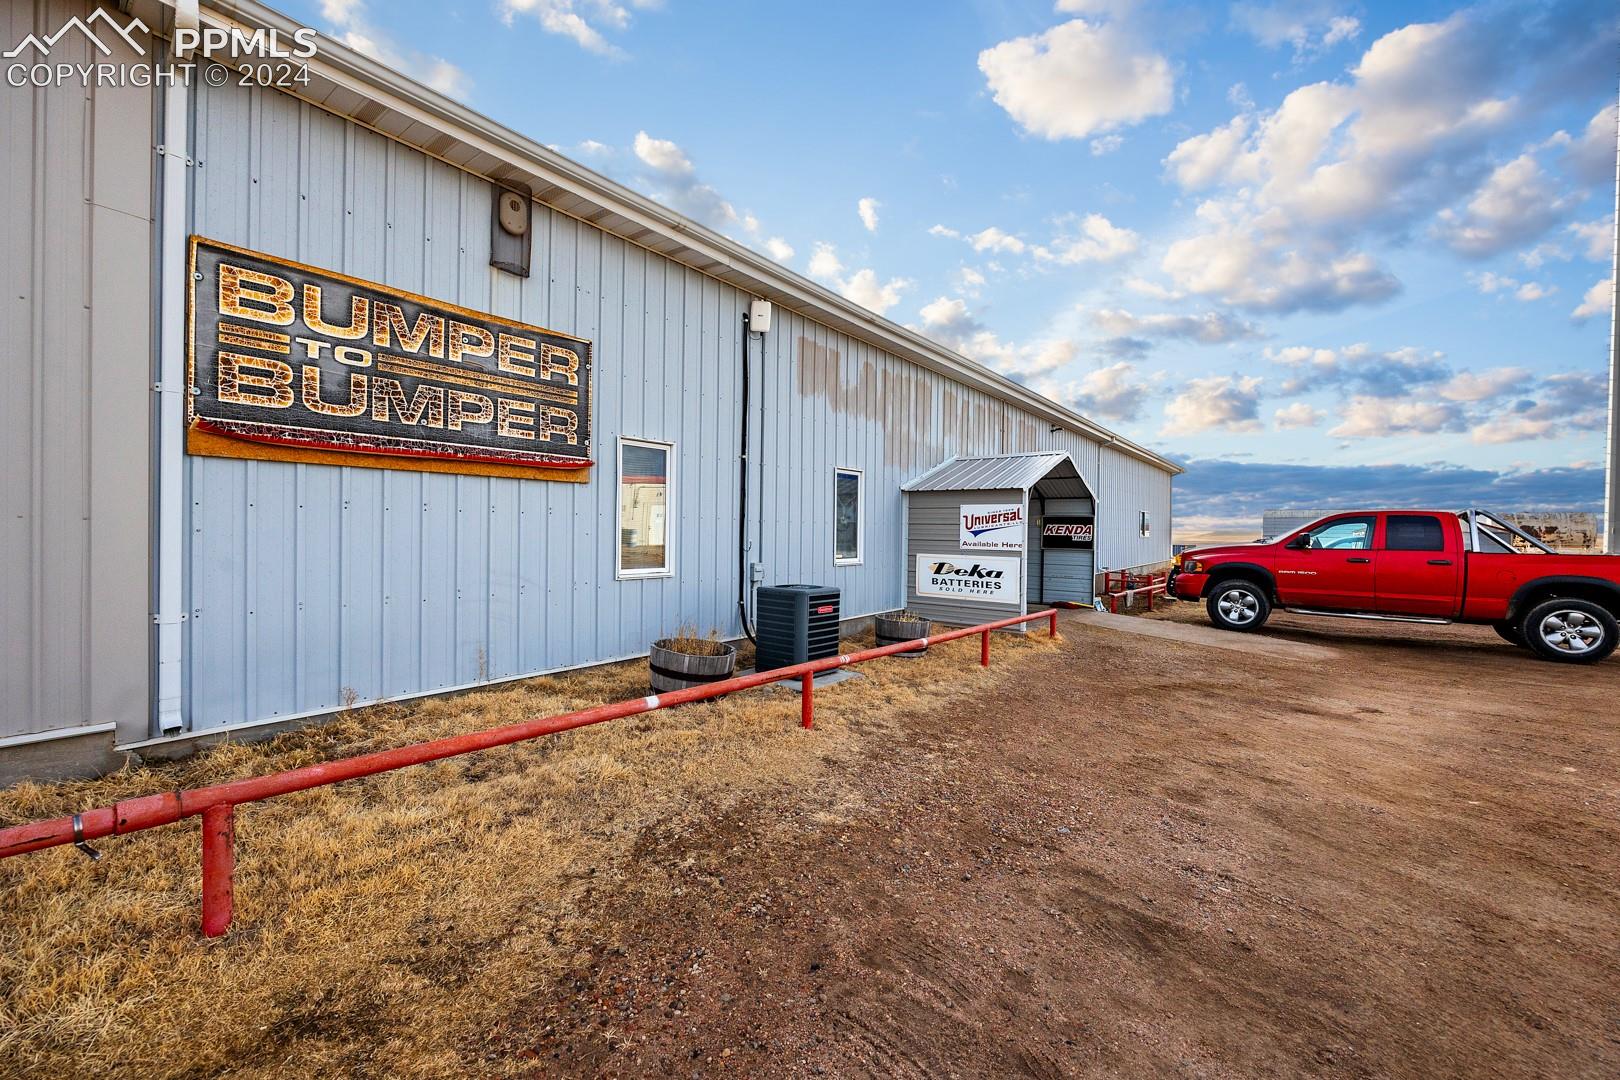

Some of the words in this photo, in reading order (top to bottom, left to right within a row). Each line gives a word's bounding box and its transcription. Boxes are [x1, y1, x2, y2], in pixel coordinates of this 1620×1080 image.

[218, 263, 579, 387] BUMPER
[295, 337, 372, 368] TO
[217, 350, 578, 446] BUMPER
[962, 507, 1023, 530] Universal
[1043, 524, 1093, 536] KENDA
[932, 562, 1004, 579] Deka
[931, 577, 1002, 590] BATTERIES
